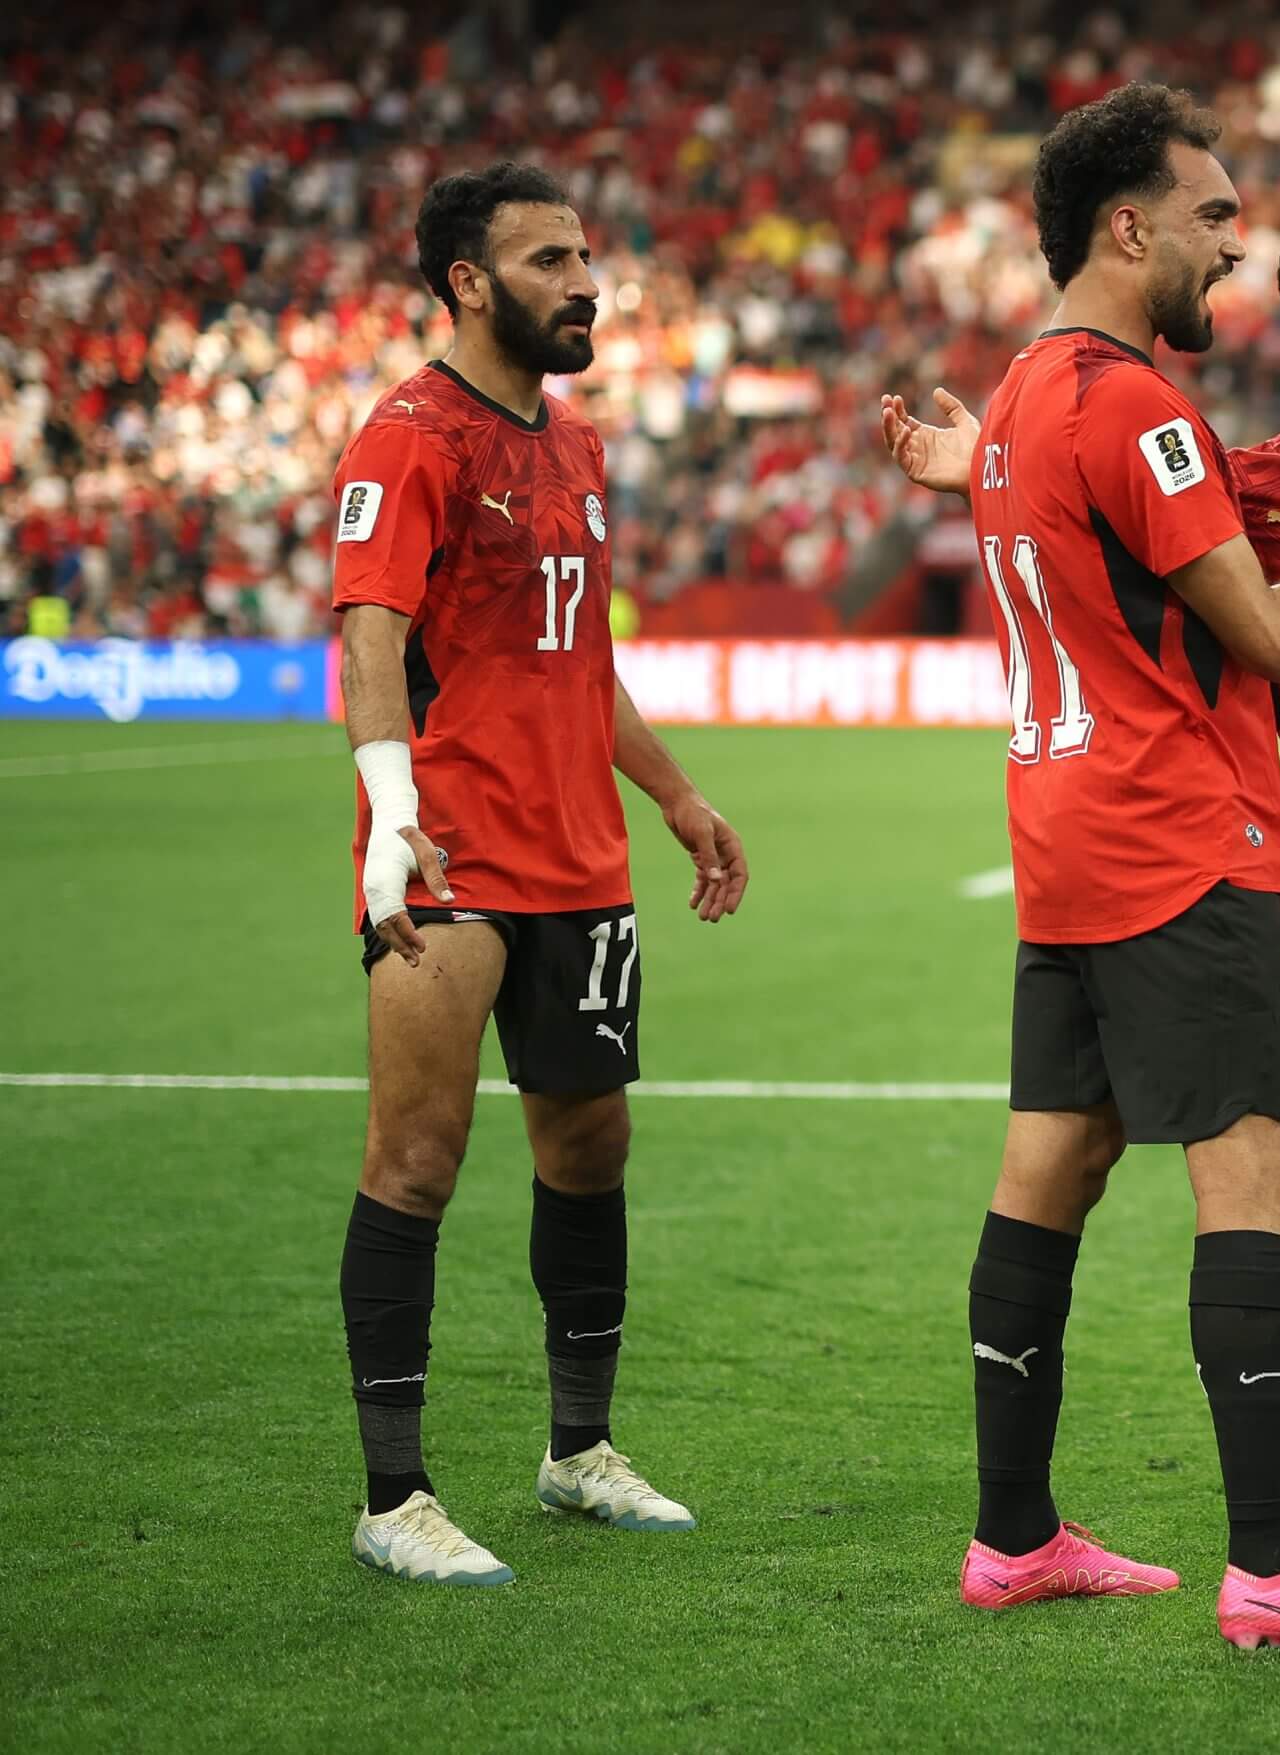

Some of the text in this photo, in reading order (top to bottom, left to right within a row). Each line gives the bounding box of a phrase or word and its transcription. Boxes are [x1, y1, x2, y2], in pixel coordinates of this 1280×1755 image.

[1173, 472, 1195, 487] 2026
[537, 555, 585, 651] 17
[984, 535, 1095, 765] 11
[578, 913, 637, 1011] 17
